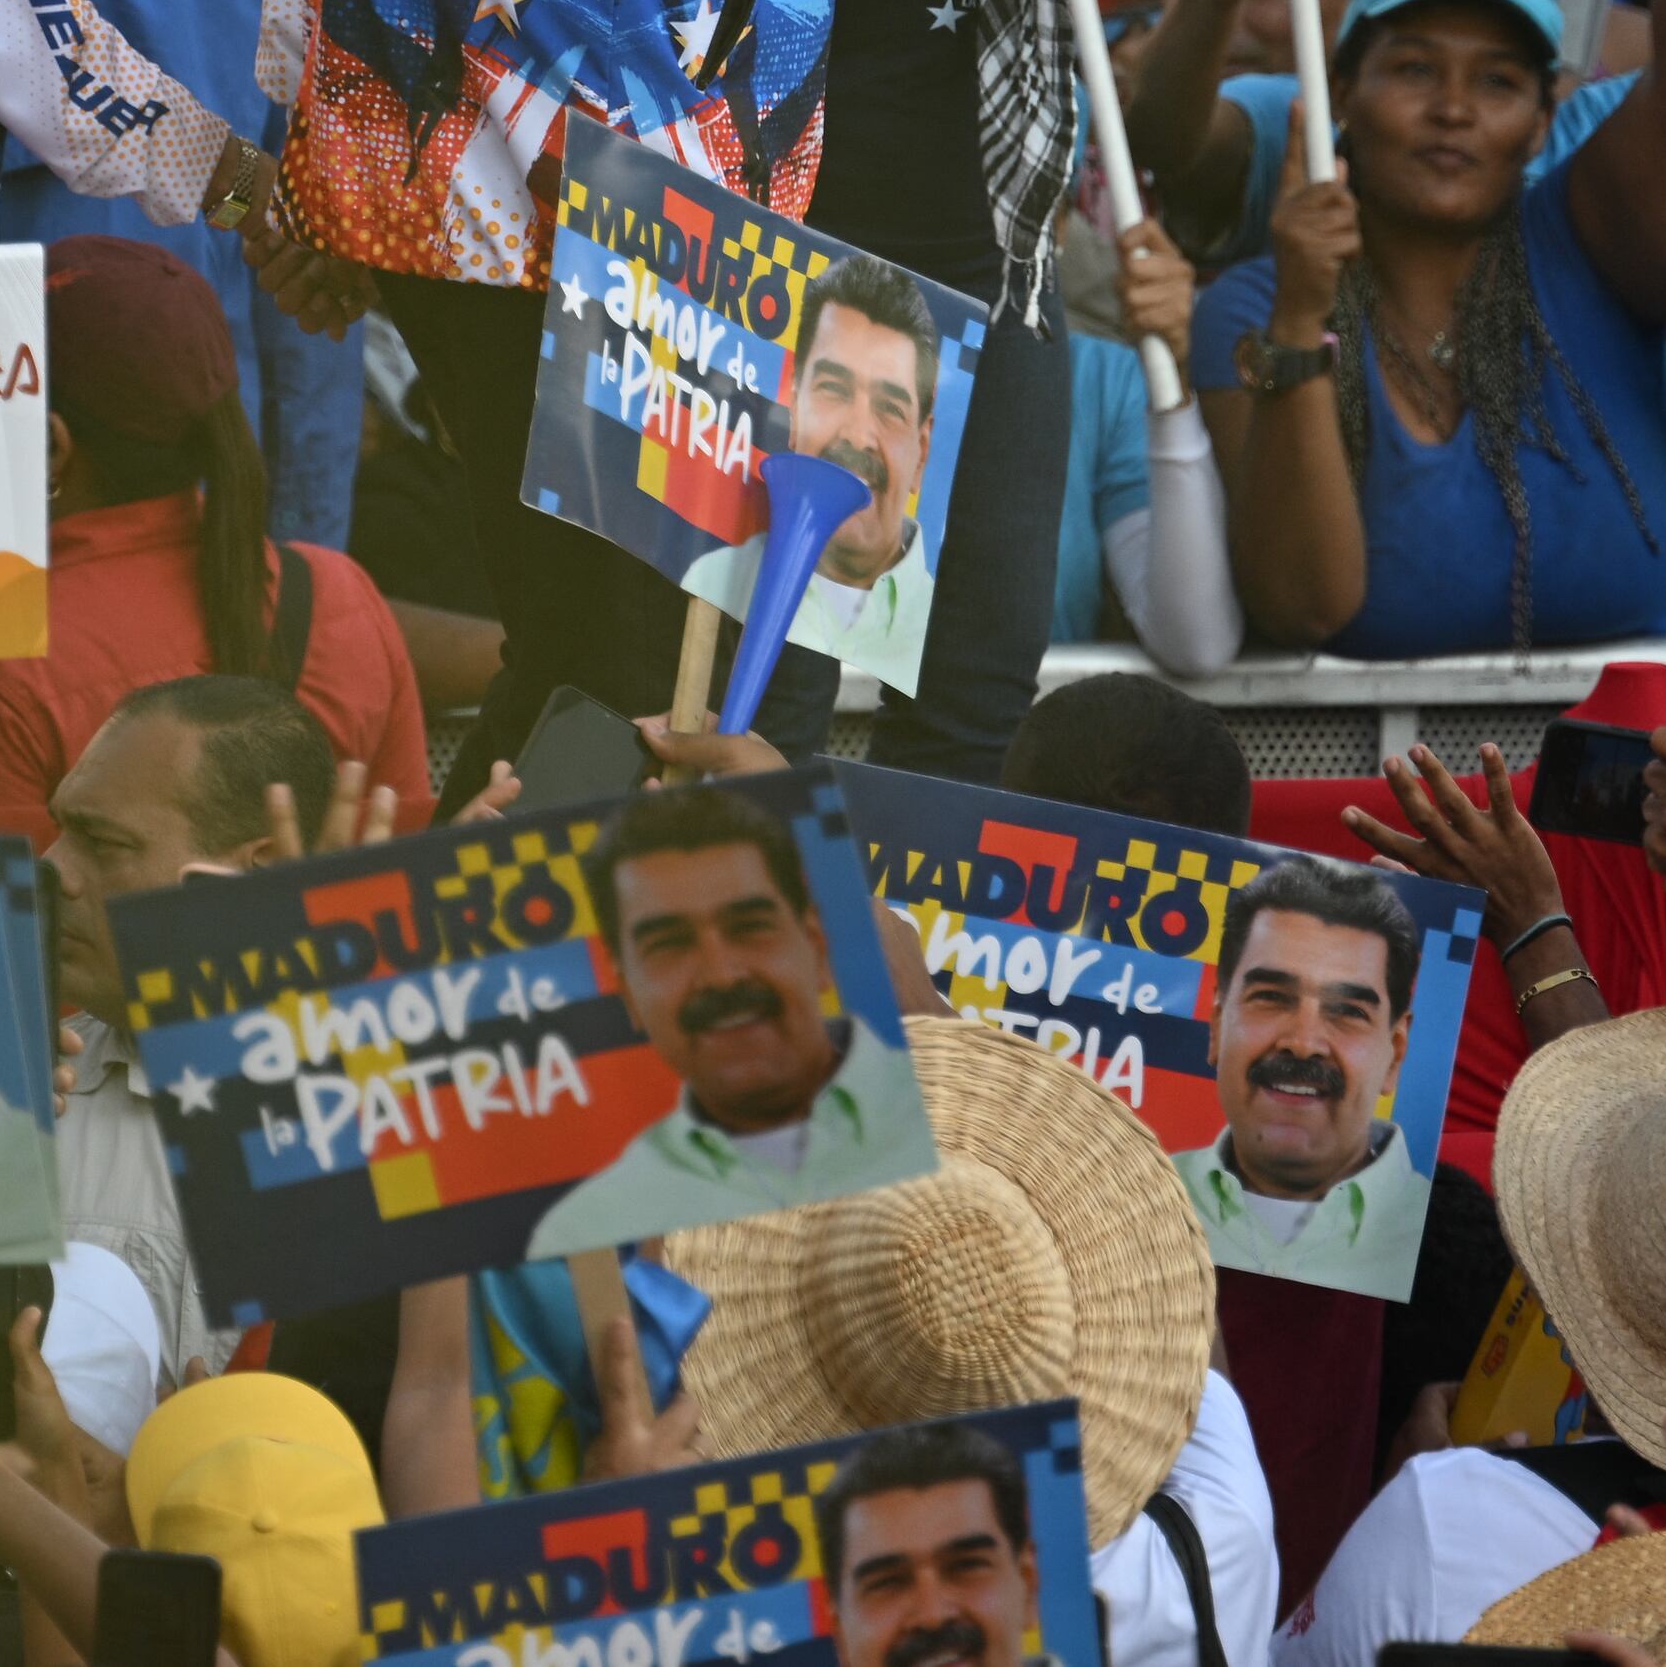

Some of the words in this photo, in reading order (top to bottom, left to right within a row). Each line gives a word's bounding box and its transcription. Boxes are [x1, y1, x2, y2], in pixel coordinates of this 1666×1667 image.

[604, 259, 727, 376] amor
[727, 341, 760, 394] de
[600, 339, 618, 385] la
[619, 331, 752, 485] PATRIA
[232, 965, 482, 1086] amor
[495, 966, 567, 1023] de
[1101, 963, 1163, 1016] de
[260, 1105, 297, 1158] la
[294, 1033, 590, 1171] PATRIA
[712, 1608, 784, 1665] de
